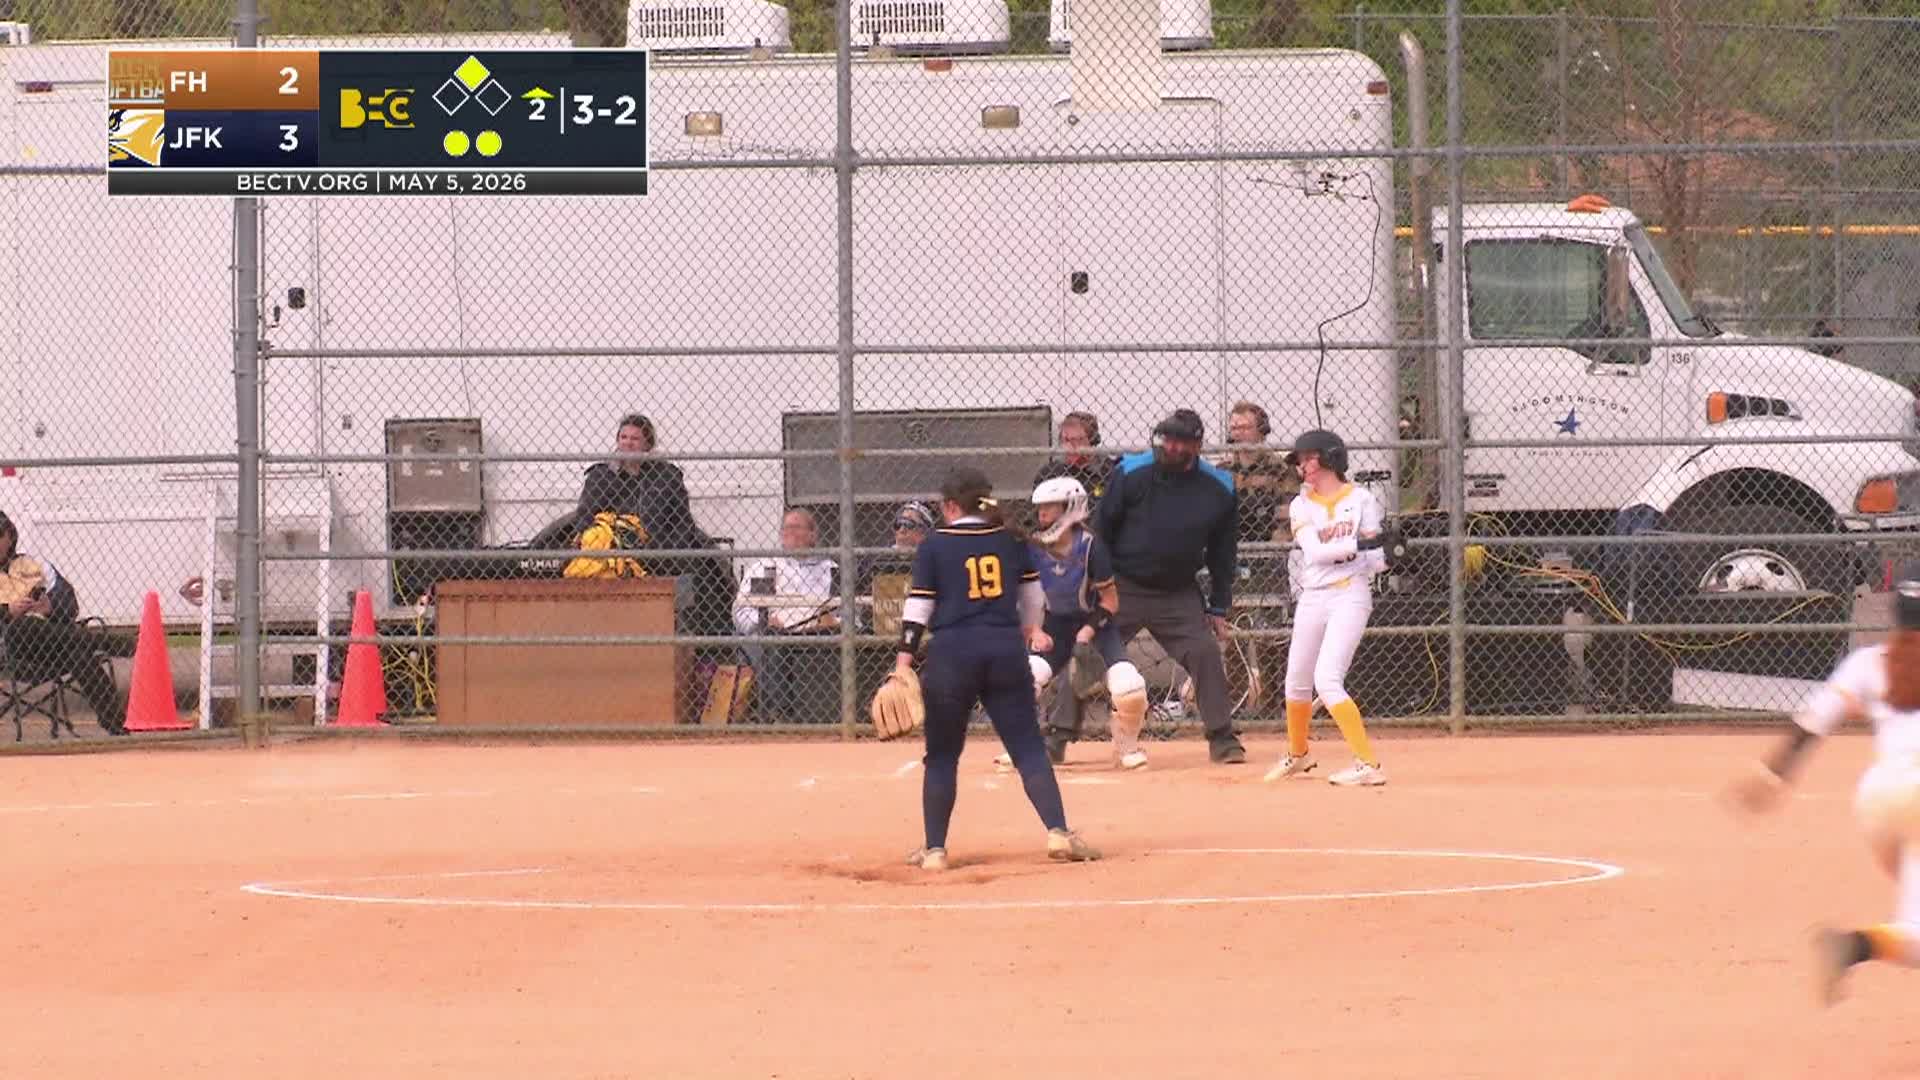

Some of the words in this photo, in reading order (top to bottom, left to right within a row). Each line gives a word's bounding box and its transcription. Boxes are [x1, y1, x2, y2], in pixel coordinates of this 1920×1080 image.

[1671, 353, 1690, 365] 136
[1511, 394, 1630, 414] BLOOMINGTON
[965, 555, 1003, 599] 19
